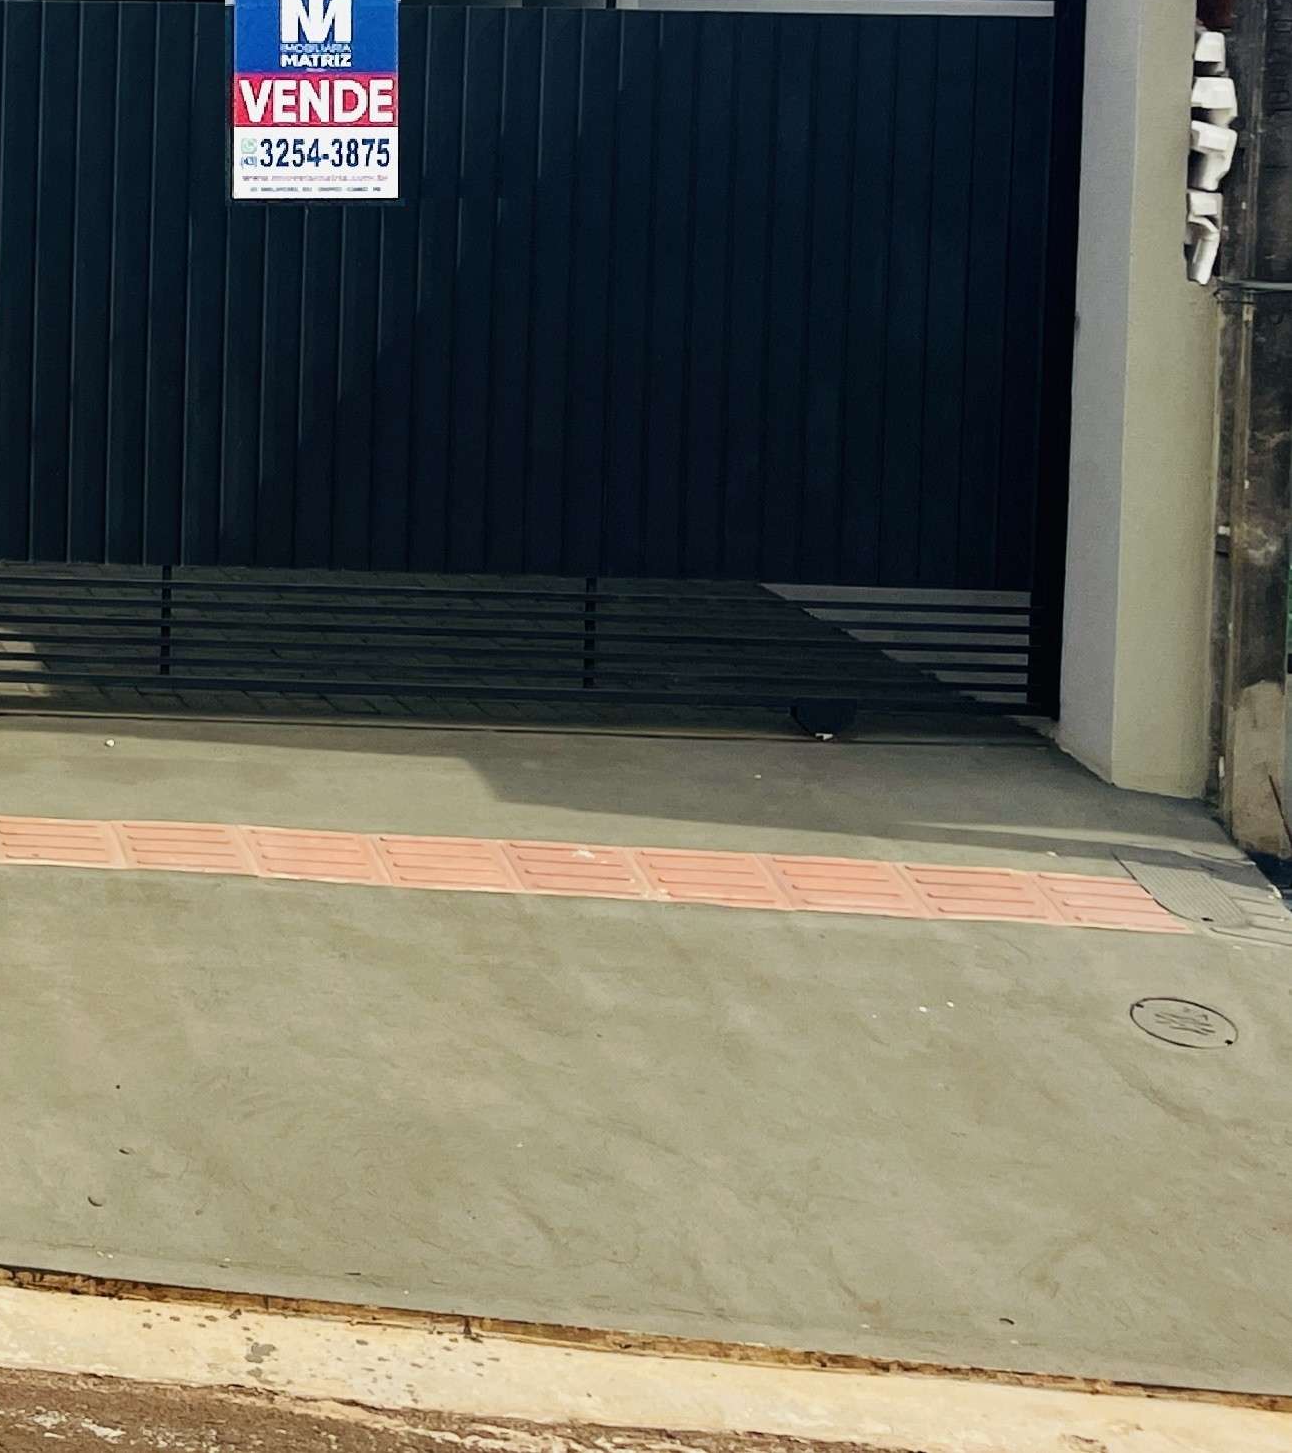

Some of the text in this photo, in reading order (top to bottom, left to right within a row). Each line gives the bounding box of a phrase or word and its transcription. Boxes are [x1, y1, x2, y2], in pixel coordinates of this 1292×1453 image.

[281, 54, 352, 68] MATRIZ
[239, 79, 394, 123] VENDE
[260, 138, 390, 167] 3254-3875
